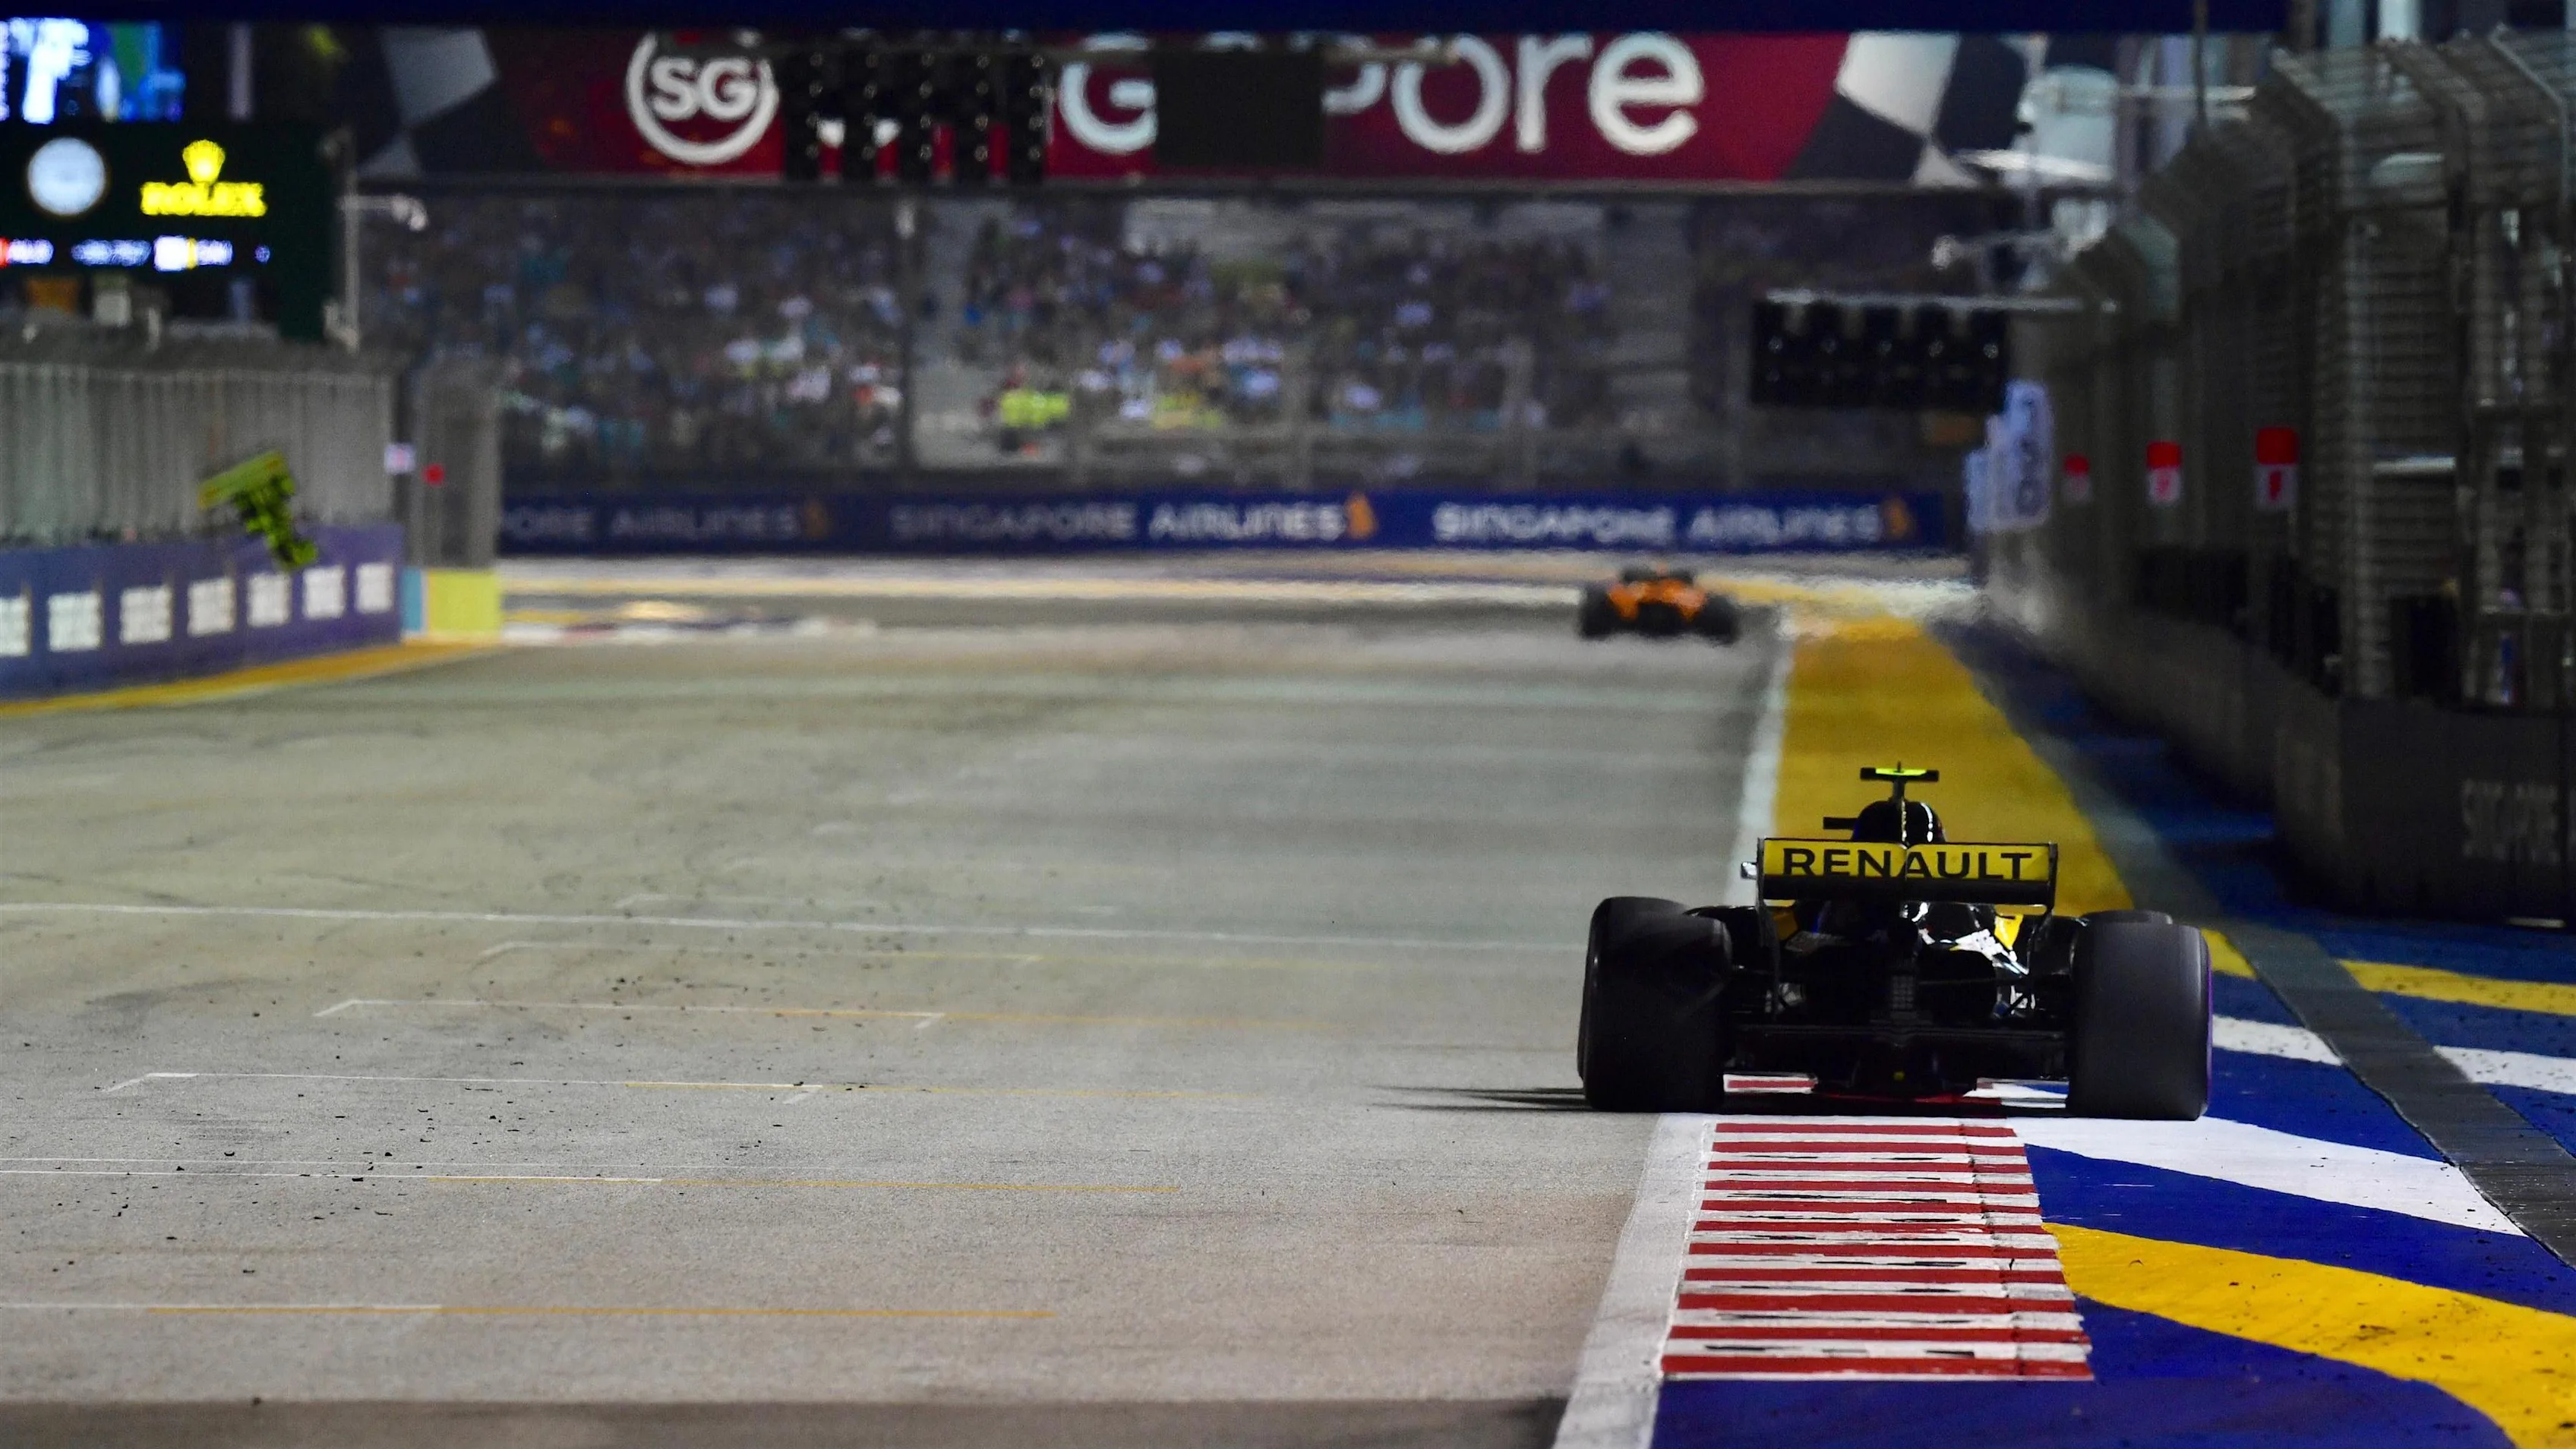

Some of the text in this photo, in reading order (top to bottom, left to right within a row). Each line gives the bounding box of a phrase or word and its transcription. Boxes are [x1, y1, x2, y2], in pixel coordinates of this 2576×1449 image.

[649, 55, 759, 122] SG
[891, 502, 1343, 541] SINGAPORE AIRLINES
[1432, 501, 1881, 545] SINGAPORE AIRLINES
[1782, 847, 2032, 881] RENAULT
